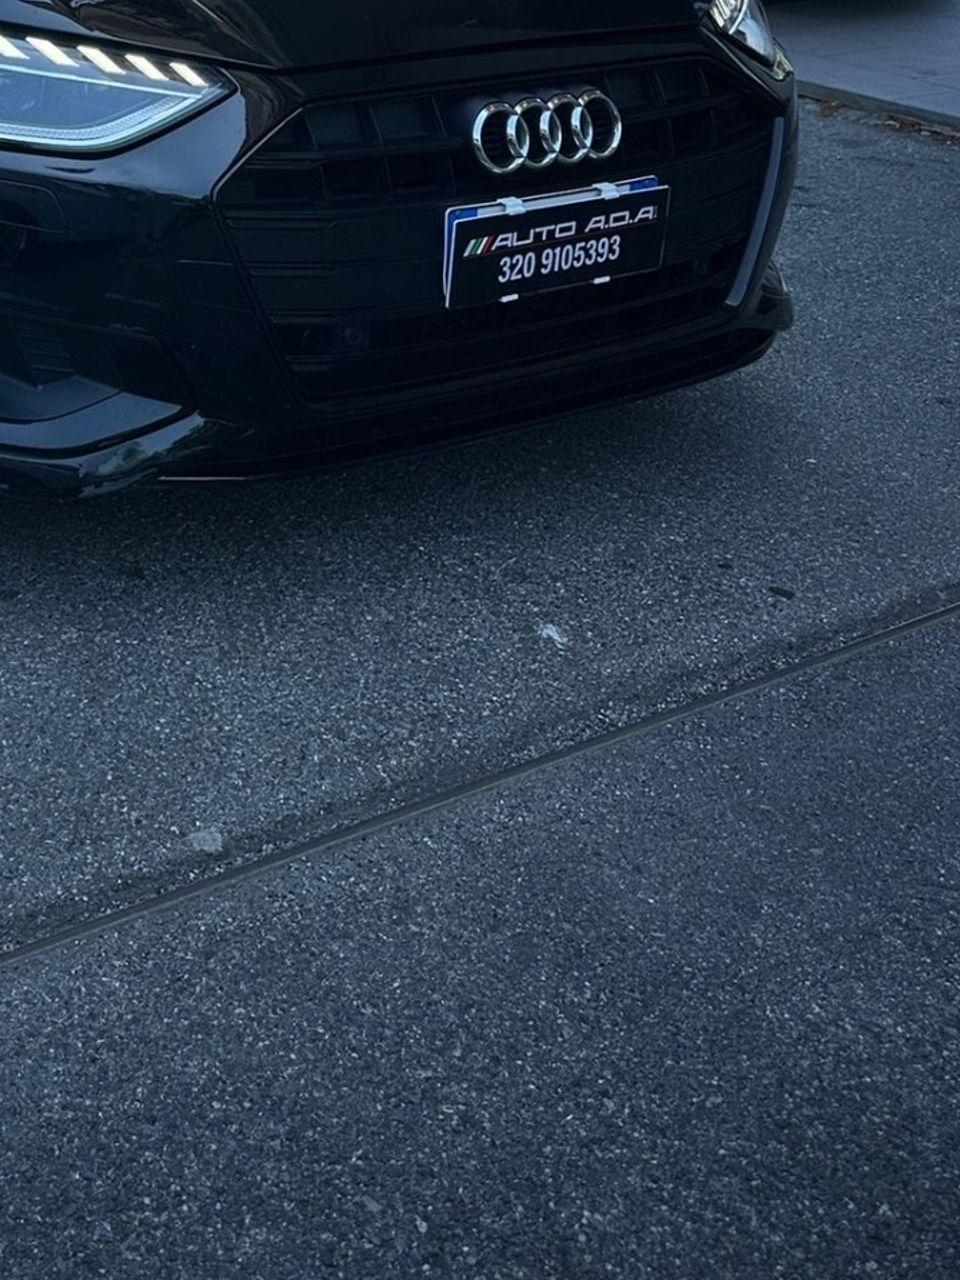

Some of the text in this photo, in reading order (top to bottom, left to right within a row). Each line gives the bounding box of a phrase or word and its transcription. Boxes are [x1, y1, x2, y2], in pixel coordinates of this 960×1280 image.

[491, 221, 577, 251] AUTO
[497, 234, 621, 283] 320 9105393
